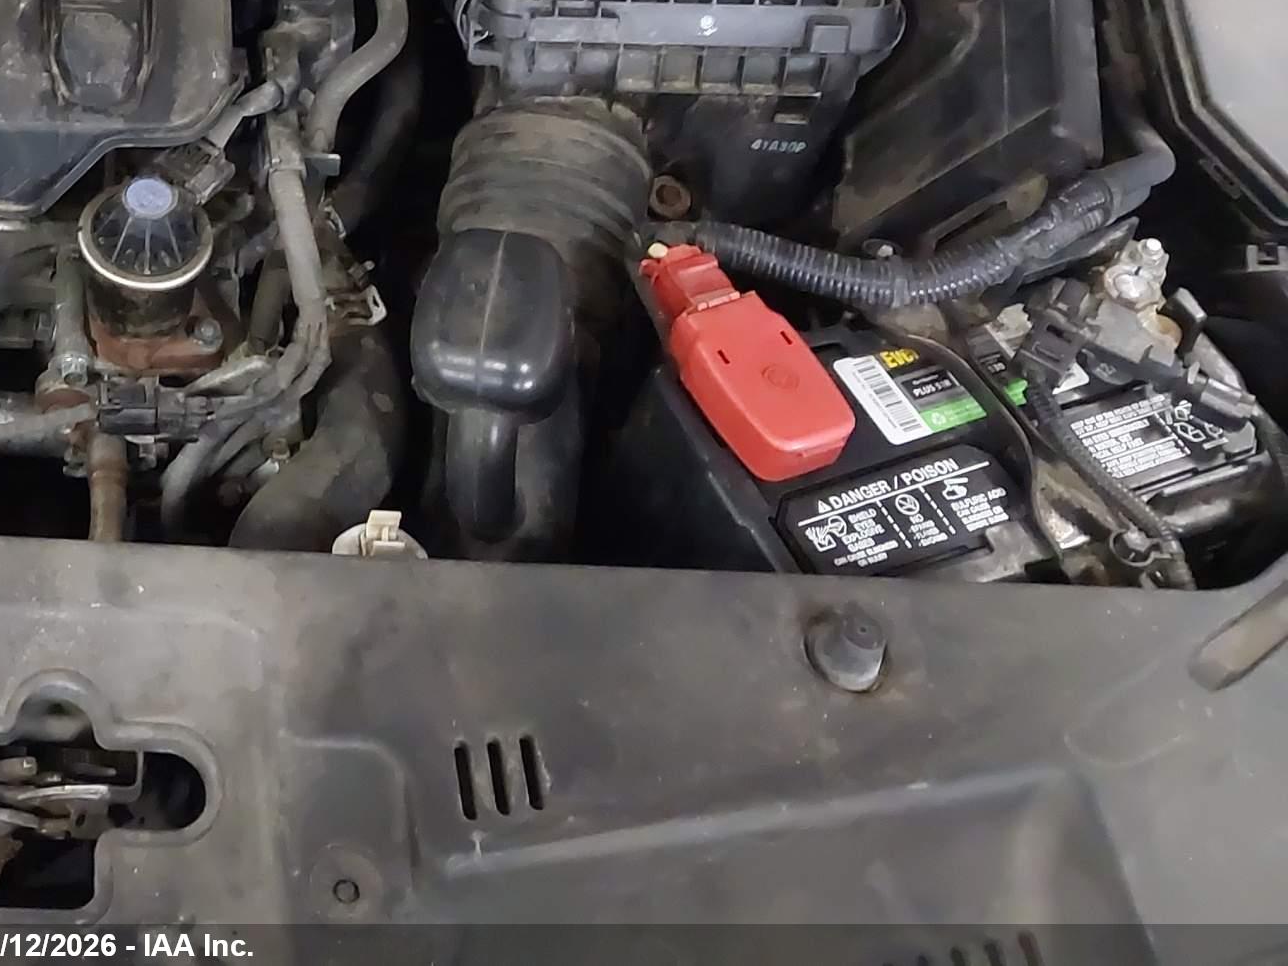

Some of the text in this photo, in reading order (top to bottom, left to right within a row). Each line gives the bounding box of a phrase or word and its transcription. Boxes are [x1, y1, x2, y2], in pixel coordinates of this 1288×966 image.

[913, 383, 937, 397] PLUS
[828, 479, 891, 509] DANGER
[900, 457, 960, 486] POISON
[848, 508, 877, 524] SHIELD
[909, 513, 924, 524] NO
[842, 524, 886, 546] EXPLOSIVE
